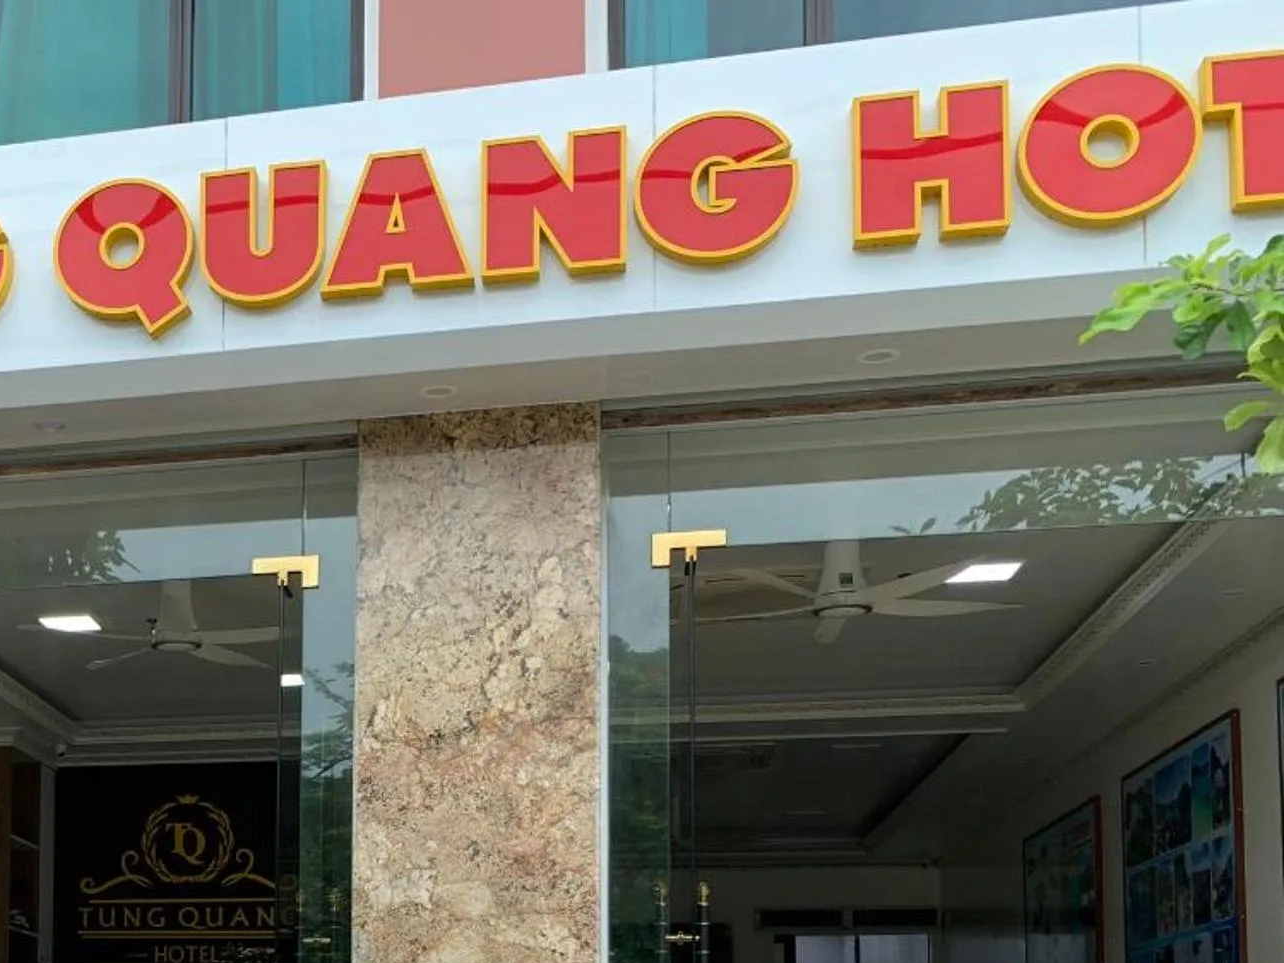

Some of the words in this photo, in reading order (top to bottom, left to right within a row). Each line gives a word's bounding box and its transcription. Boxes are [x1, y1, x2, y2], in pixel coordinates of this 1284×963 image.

[53, 110, 800, 340] QUANG
[165, 822, 207, 866] TQ
[77, 906, 165, 928] TUNG
[154, 945, 218, 963] HOTEL
